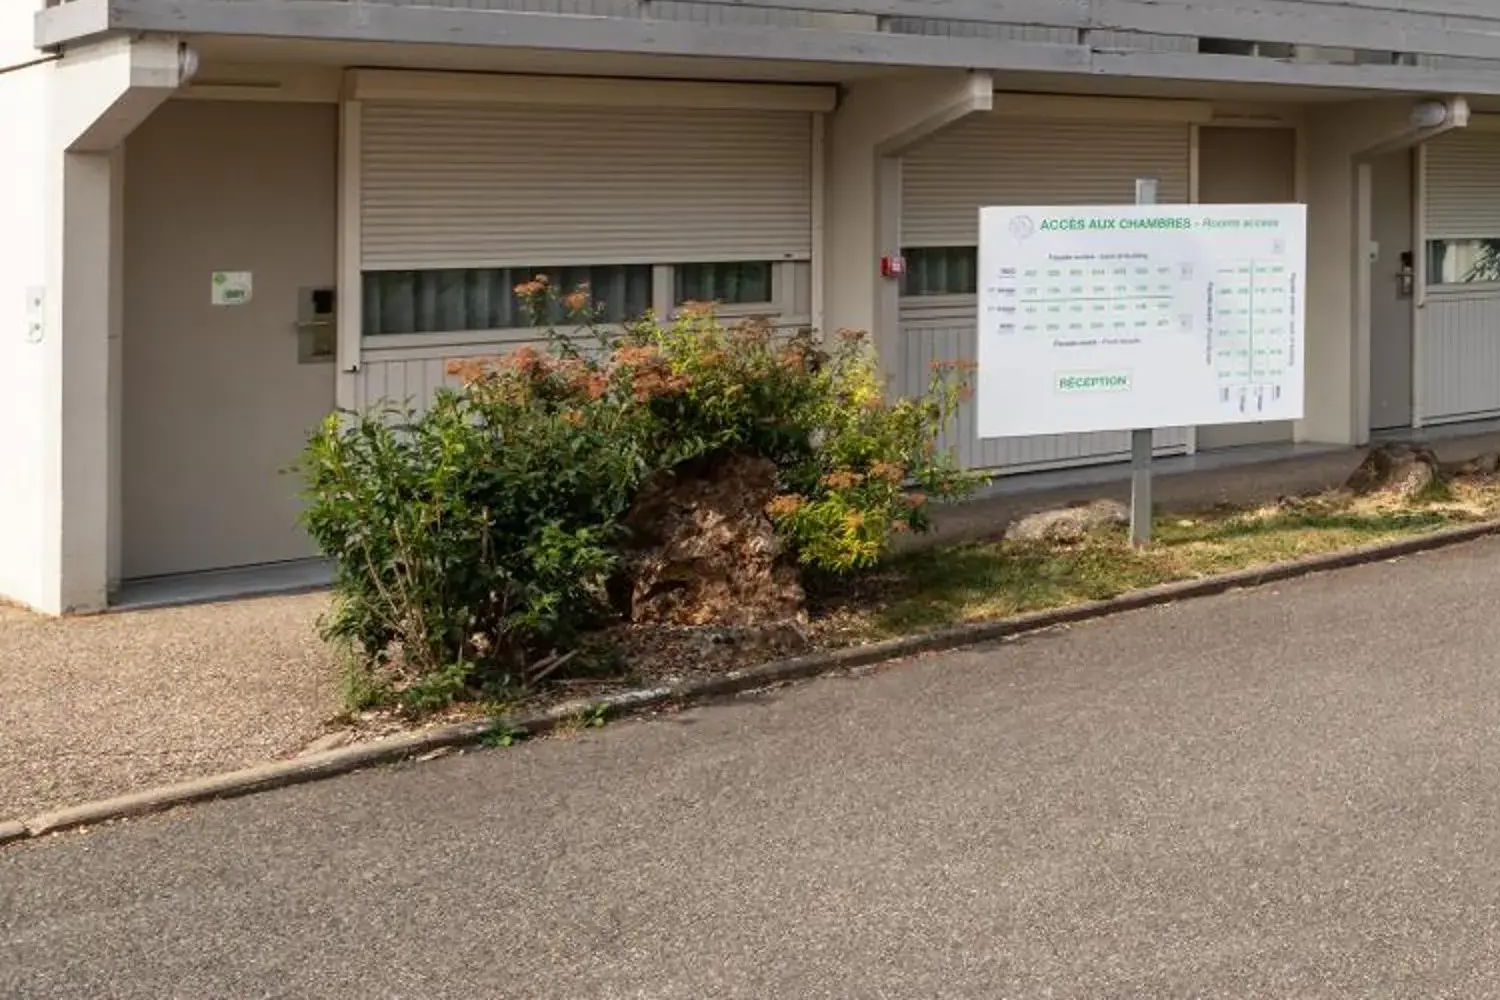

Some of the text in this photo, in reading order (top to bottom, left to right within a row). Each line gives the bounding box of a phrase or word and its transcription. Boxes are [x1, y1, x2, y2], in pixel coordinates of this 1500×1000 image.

[1040, 217, 1085, 230] ACCÈS
[1089, 218, 1115, 230] AUX
[1119, 217, 1191, 229] CHAMBRES
[1059, 375, 1127, 389] RÉCEPTION
